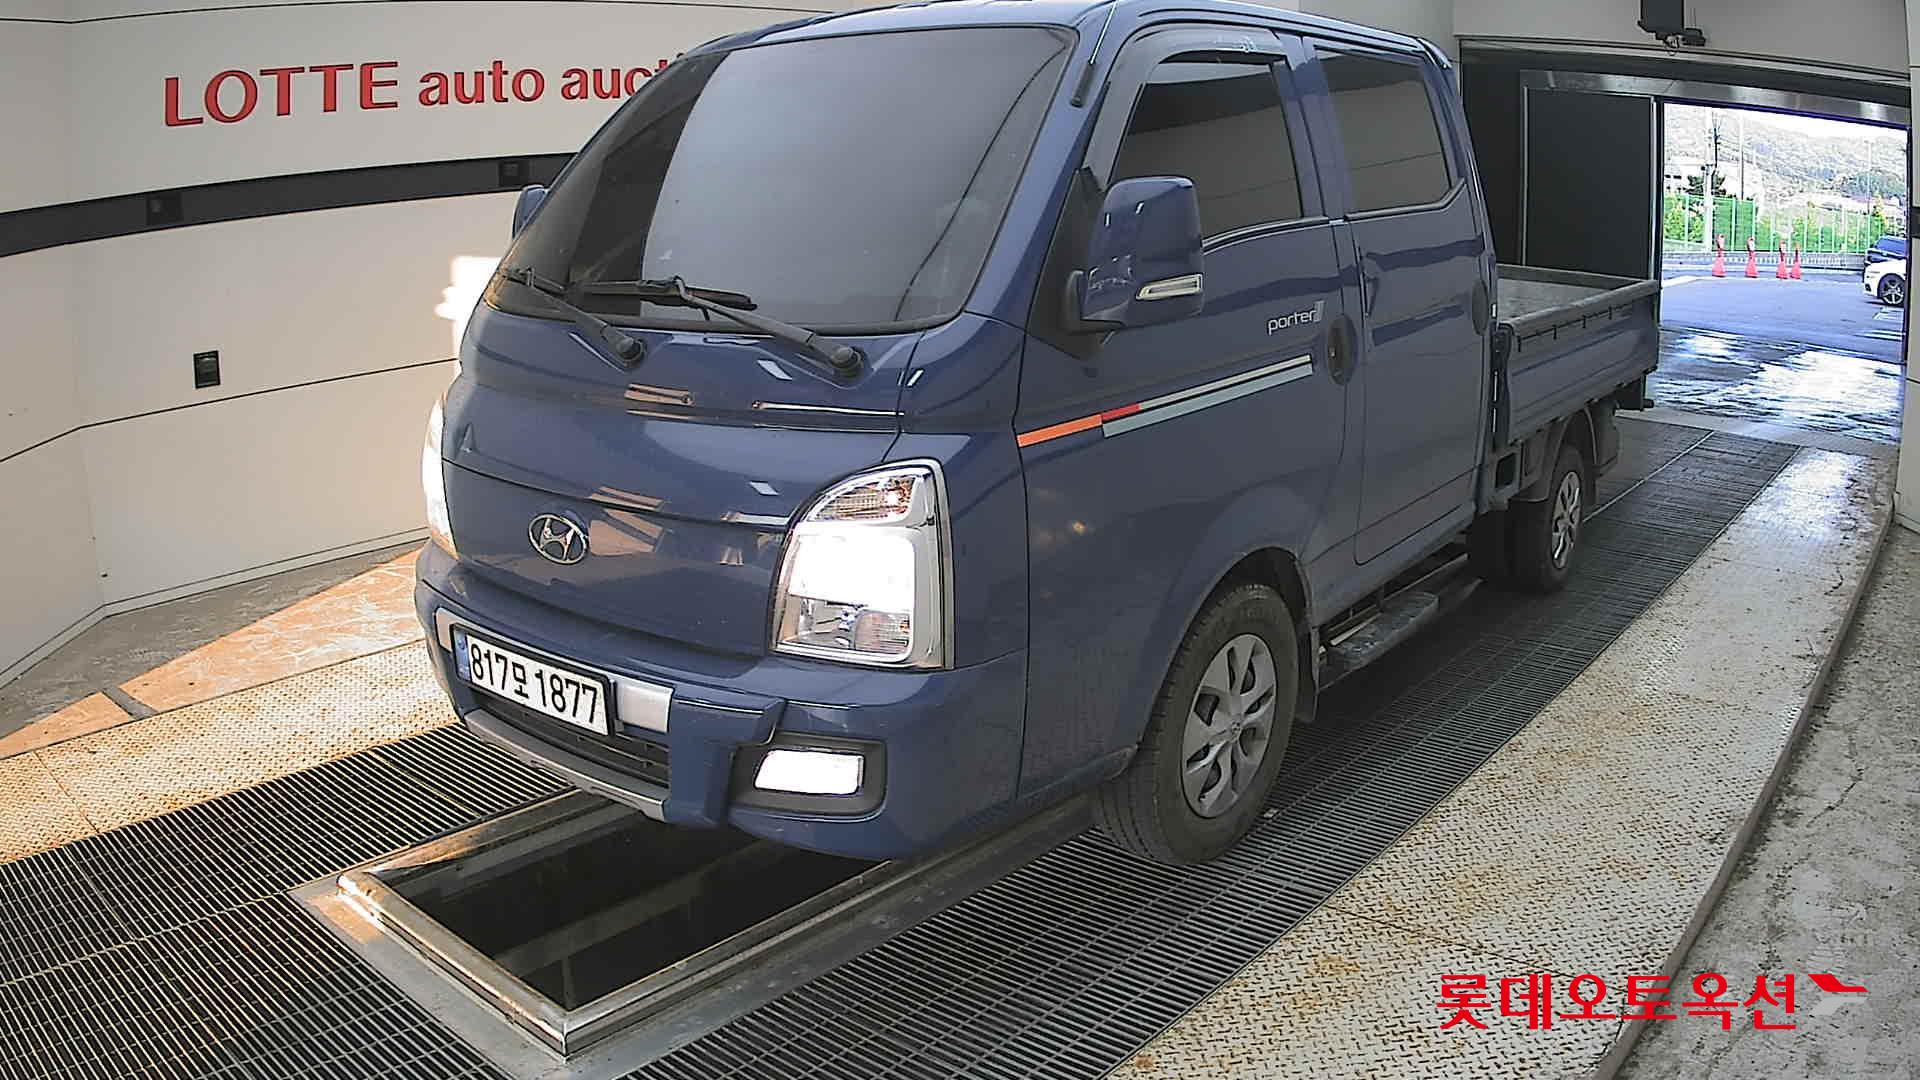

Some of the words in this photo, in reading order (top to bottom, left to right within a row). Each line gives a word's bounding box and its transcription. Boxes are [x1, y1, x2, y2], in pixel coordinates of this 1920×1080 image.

[165, 61, 398, 127] LOTTE
[418, 60, 546, 106] auto
[560, 53, 684, 100] auc
[1268, 310, 1317, 335] porter
[534, 669, 598, 723] 1877
